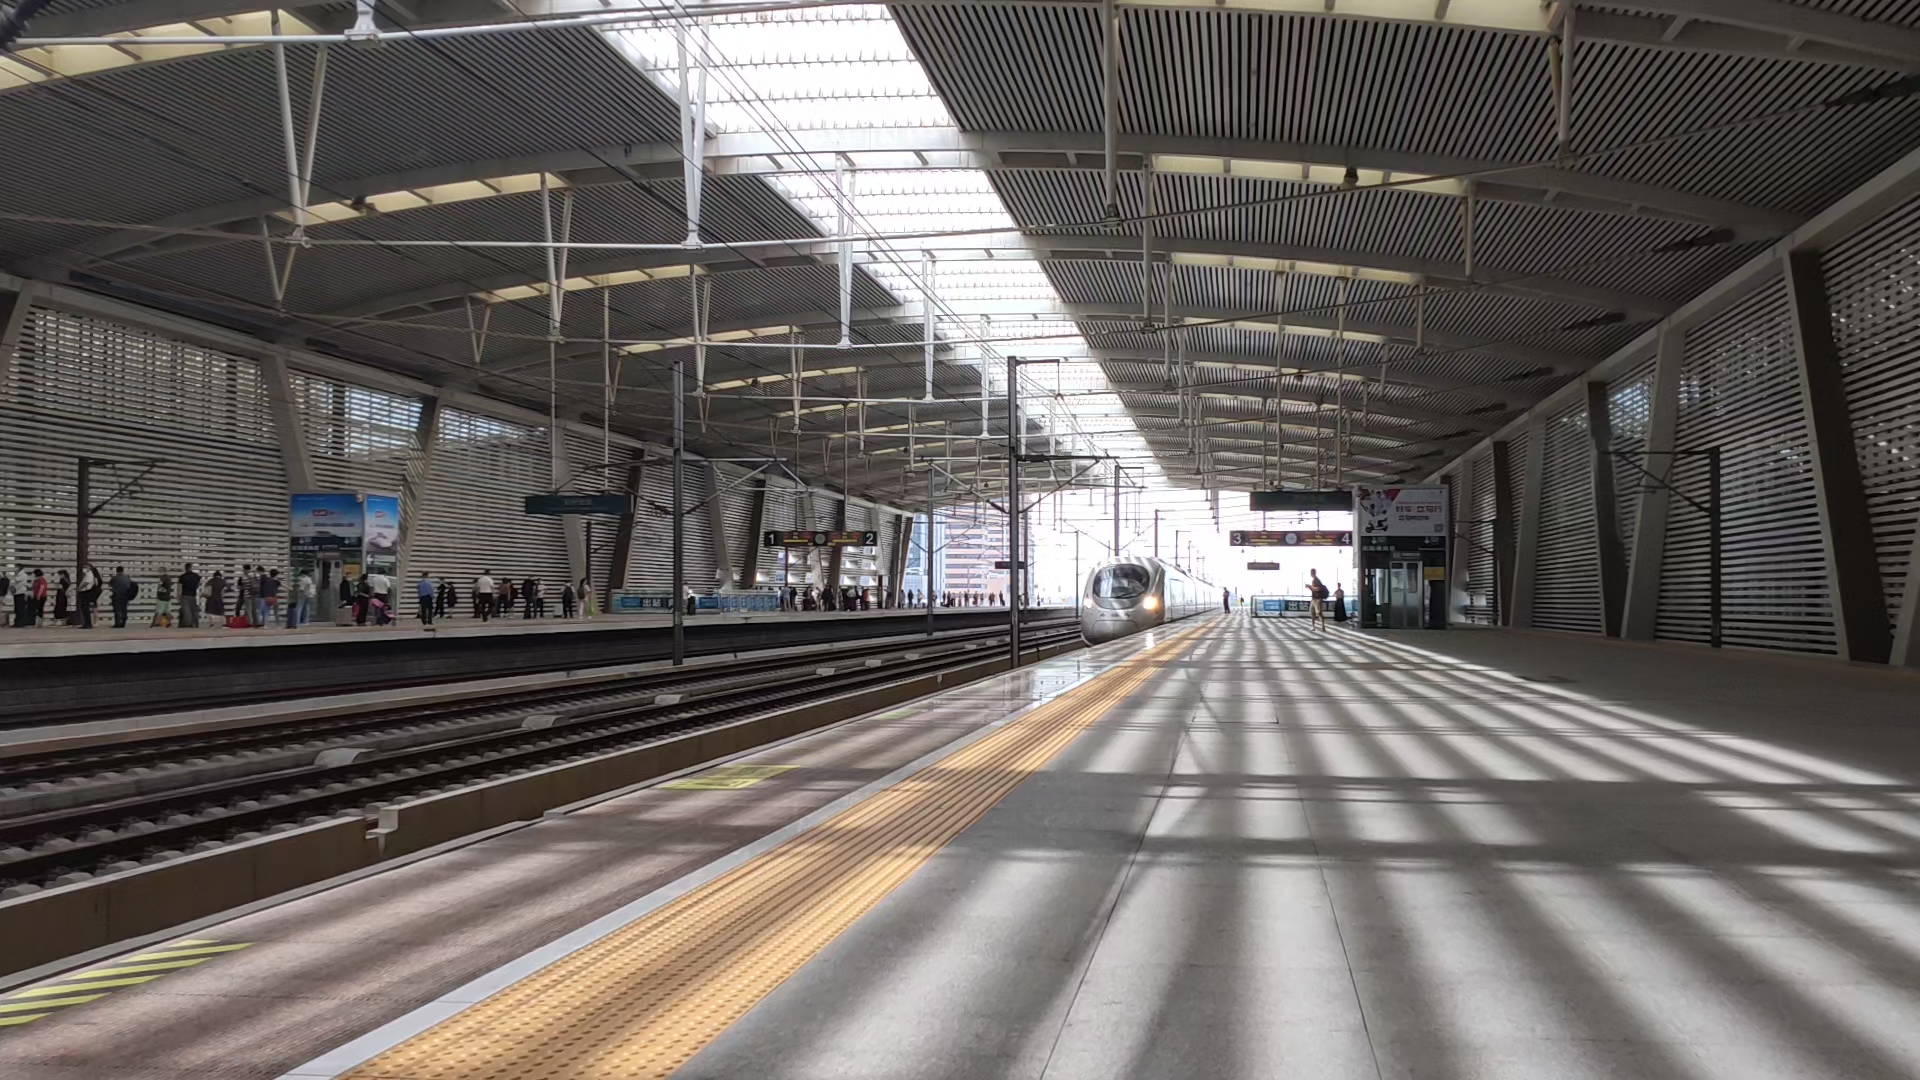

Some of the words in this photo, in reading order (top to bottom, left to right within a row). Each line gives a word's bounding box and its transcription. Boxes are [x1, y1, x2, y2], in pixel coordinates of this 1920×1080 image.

[768, 533, 775, 545] 1
[865, 533, 874, 545] 2
[1232, 532, 1242, 545] 3
[1341, 532, 1351, 545] 4
